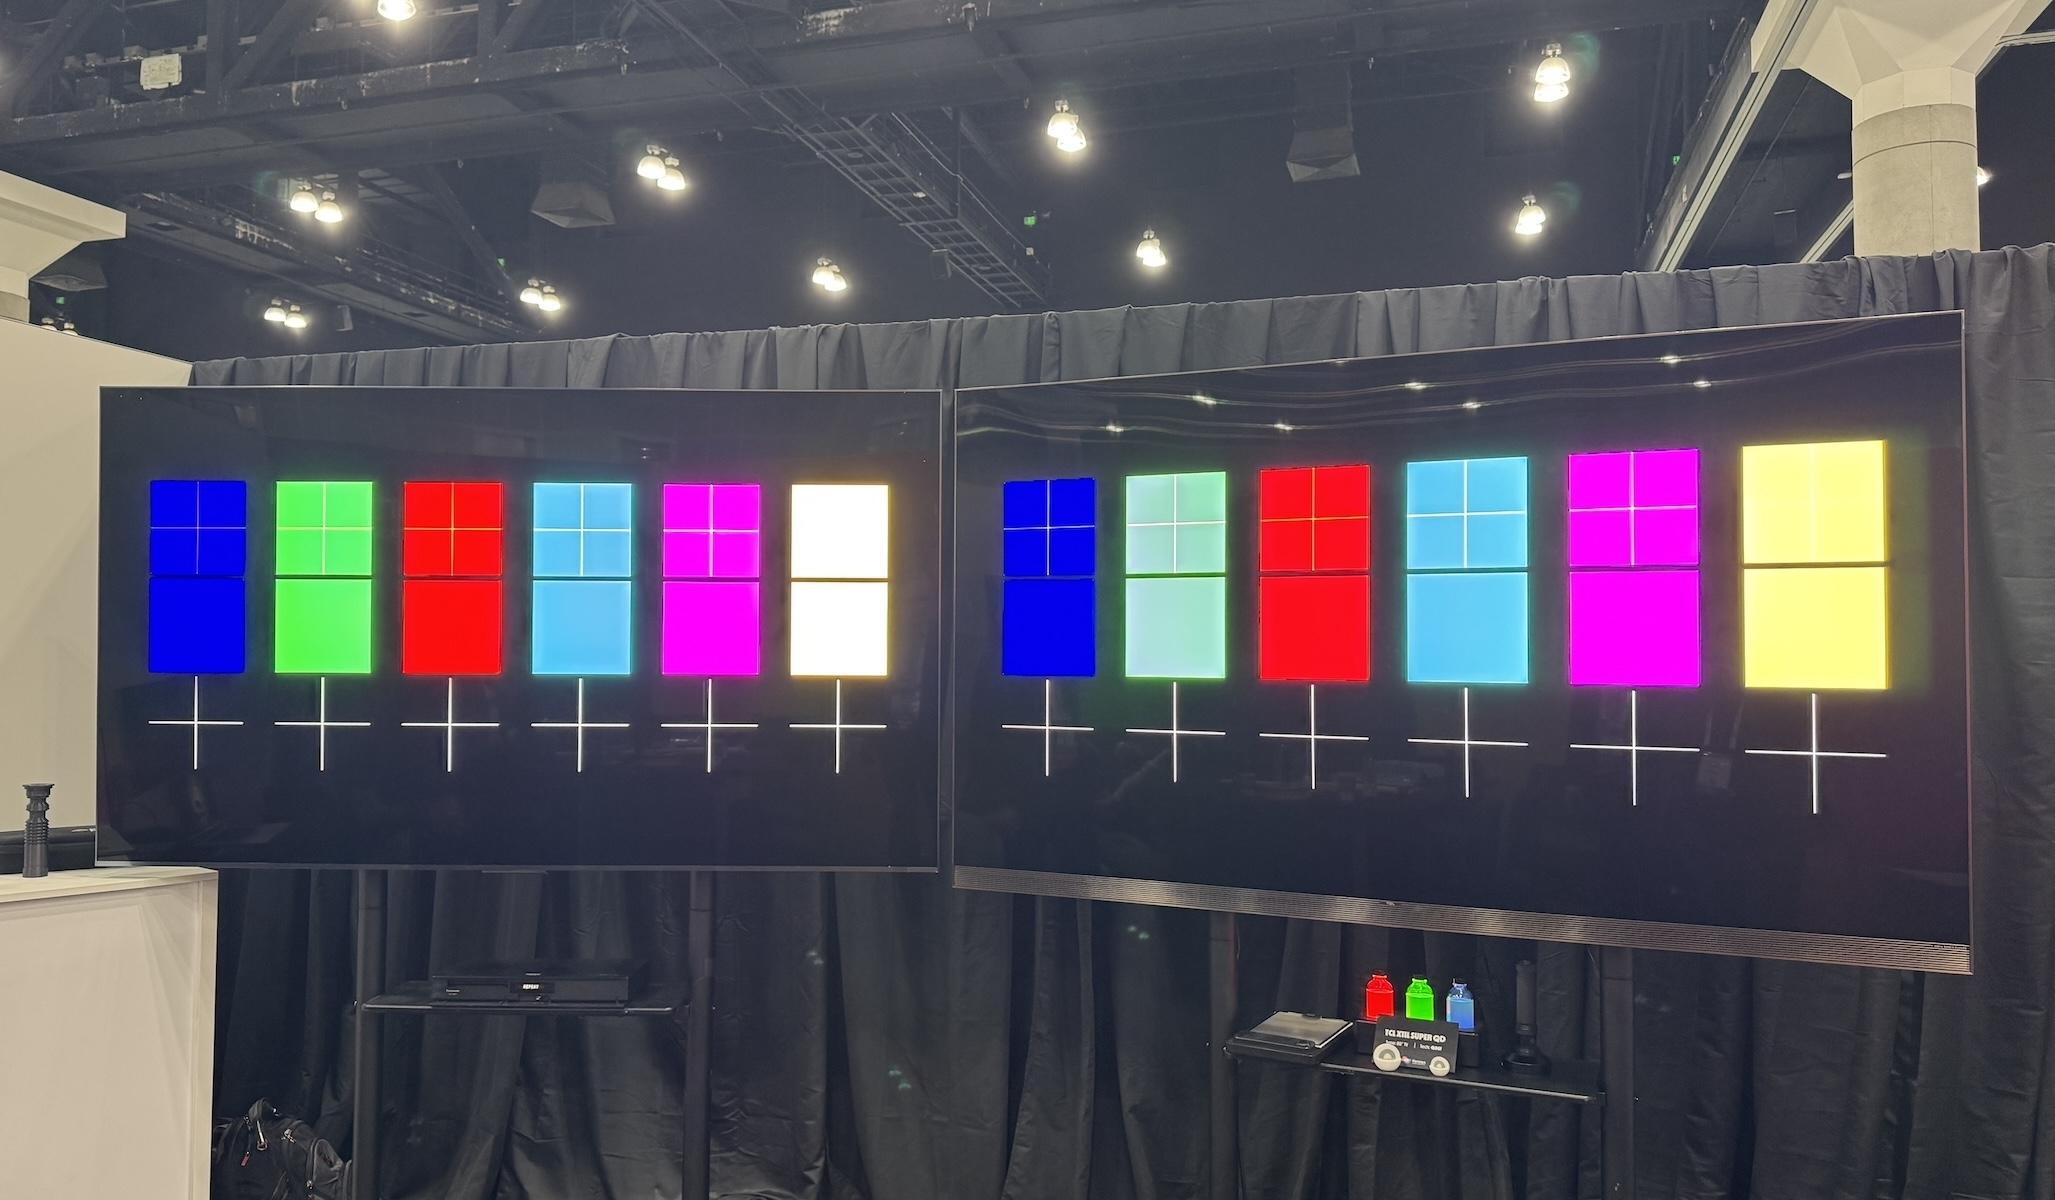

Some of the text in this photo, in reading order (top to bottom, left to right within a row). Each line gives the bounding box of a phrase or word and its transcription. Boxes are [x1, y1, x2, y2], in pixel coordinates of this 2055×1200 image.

[1385, 1028, 1396, 1037] TCL
[1410, 1031, 1433, 1042] SUPER
[1433, 1034, 1446, 1043] QD
